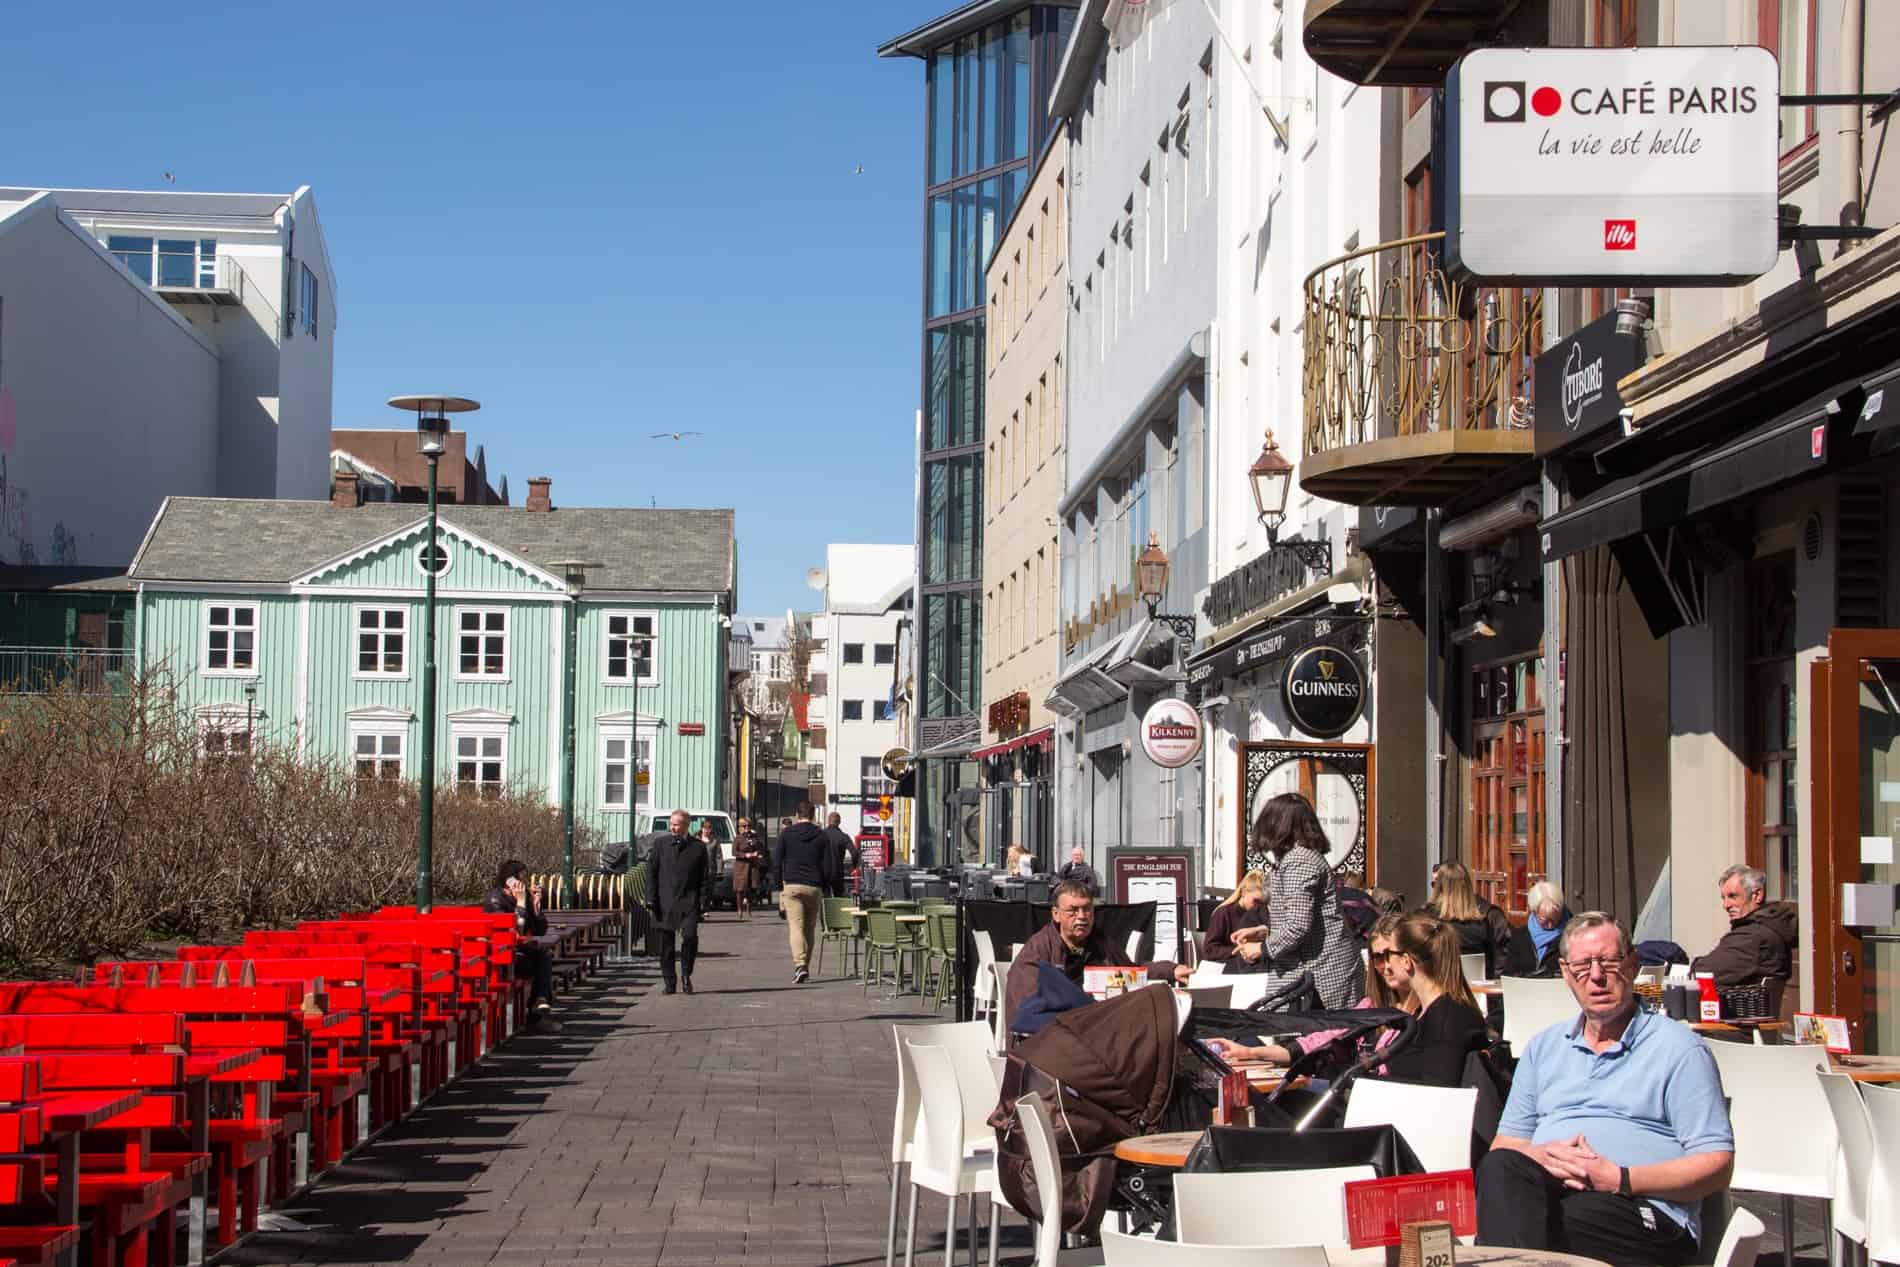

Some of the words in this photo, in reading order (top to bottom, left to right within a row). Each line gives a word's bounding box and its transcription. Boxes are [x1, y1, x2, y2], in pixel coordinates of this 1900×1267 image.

[1570, 81, 1655, 115] CAFÉ
[1669, 86, 1758, 114] PARIS
[1538, 128, 1560, 155] la
[1571, 133, 1601, 154] vie
[1610, 129, 1642, 154] est
[1649, 127, 1702, 155] belle
[1606, 224, 1635, 248] illy
[1567, 357, 1602, 405] TUBORG
[1292, 680, 1358, 697] GUINNESS
[1151, 726, 1194, 737] KILKENNY
[1137, 863, 1169, 871] ENGLISH
[1425, 1253, 1450, 1267] 202
